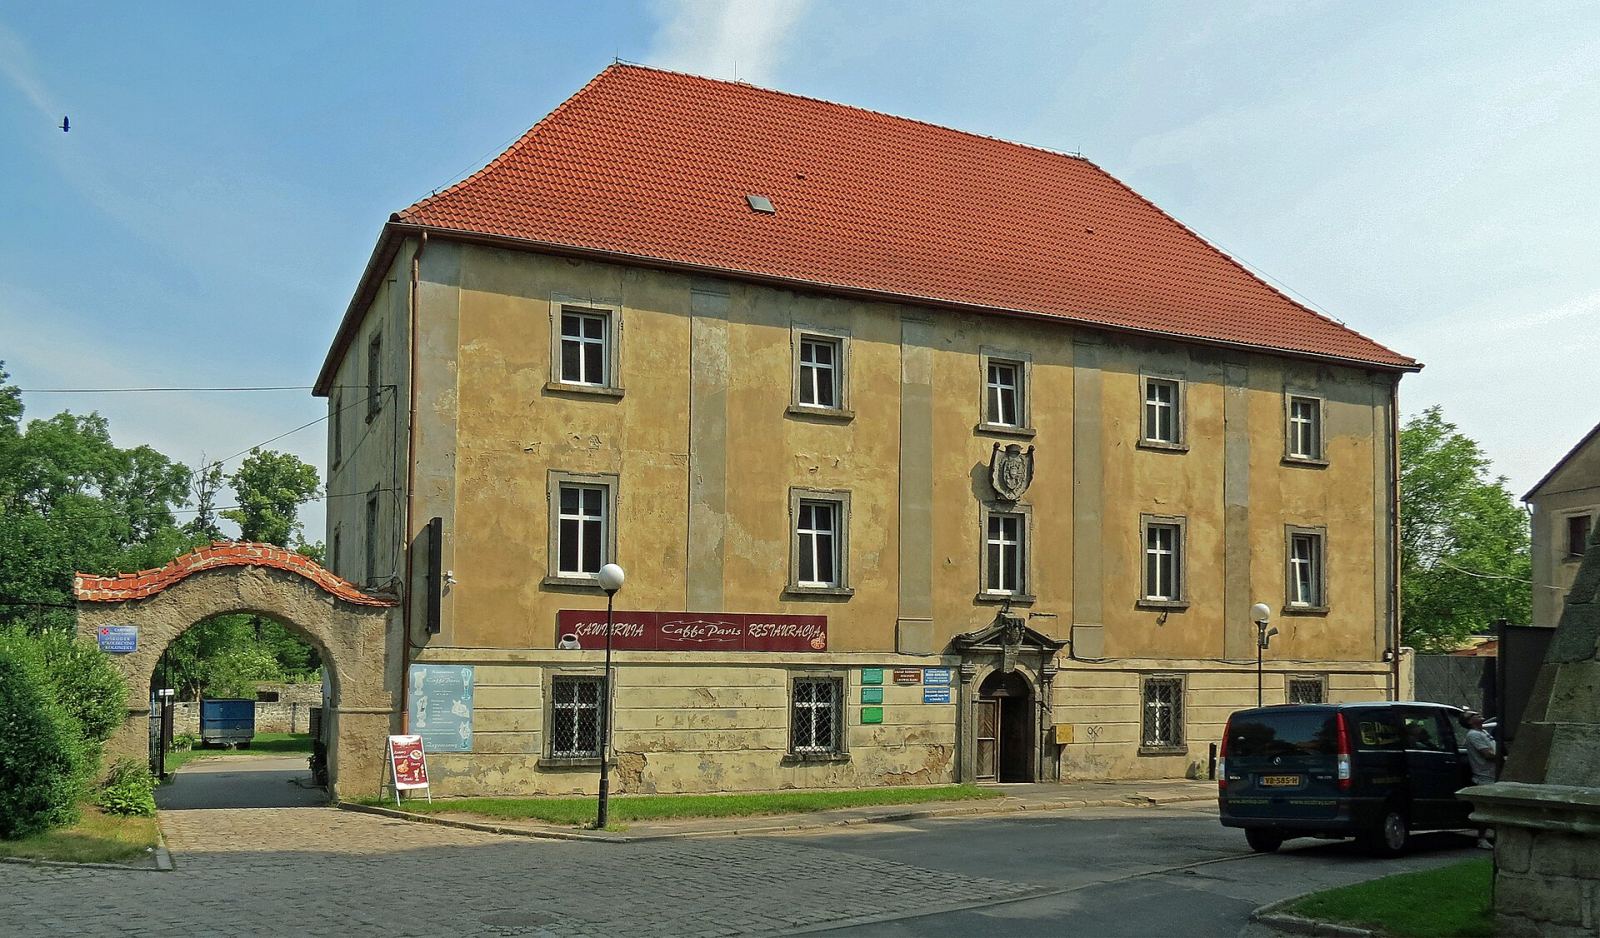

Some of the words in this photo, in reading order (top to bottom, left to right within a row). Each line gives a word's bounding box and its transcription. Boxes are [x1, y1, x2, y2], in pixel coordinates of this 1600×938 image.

[574, 622, 644, 637] KAWIARNIA
[661, 624, 705, 637] Caffe
[705, 624, 741, 637] Paris
[748, 623, 821, 641] RESTAURACJA
